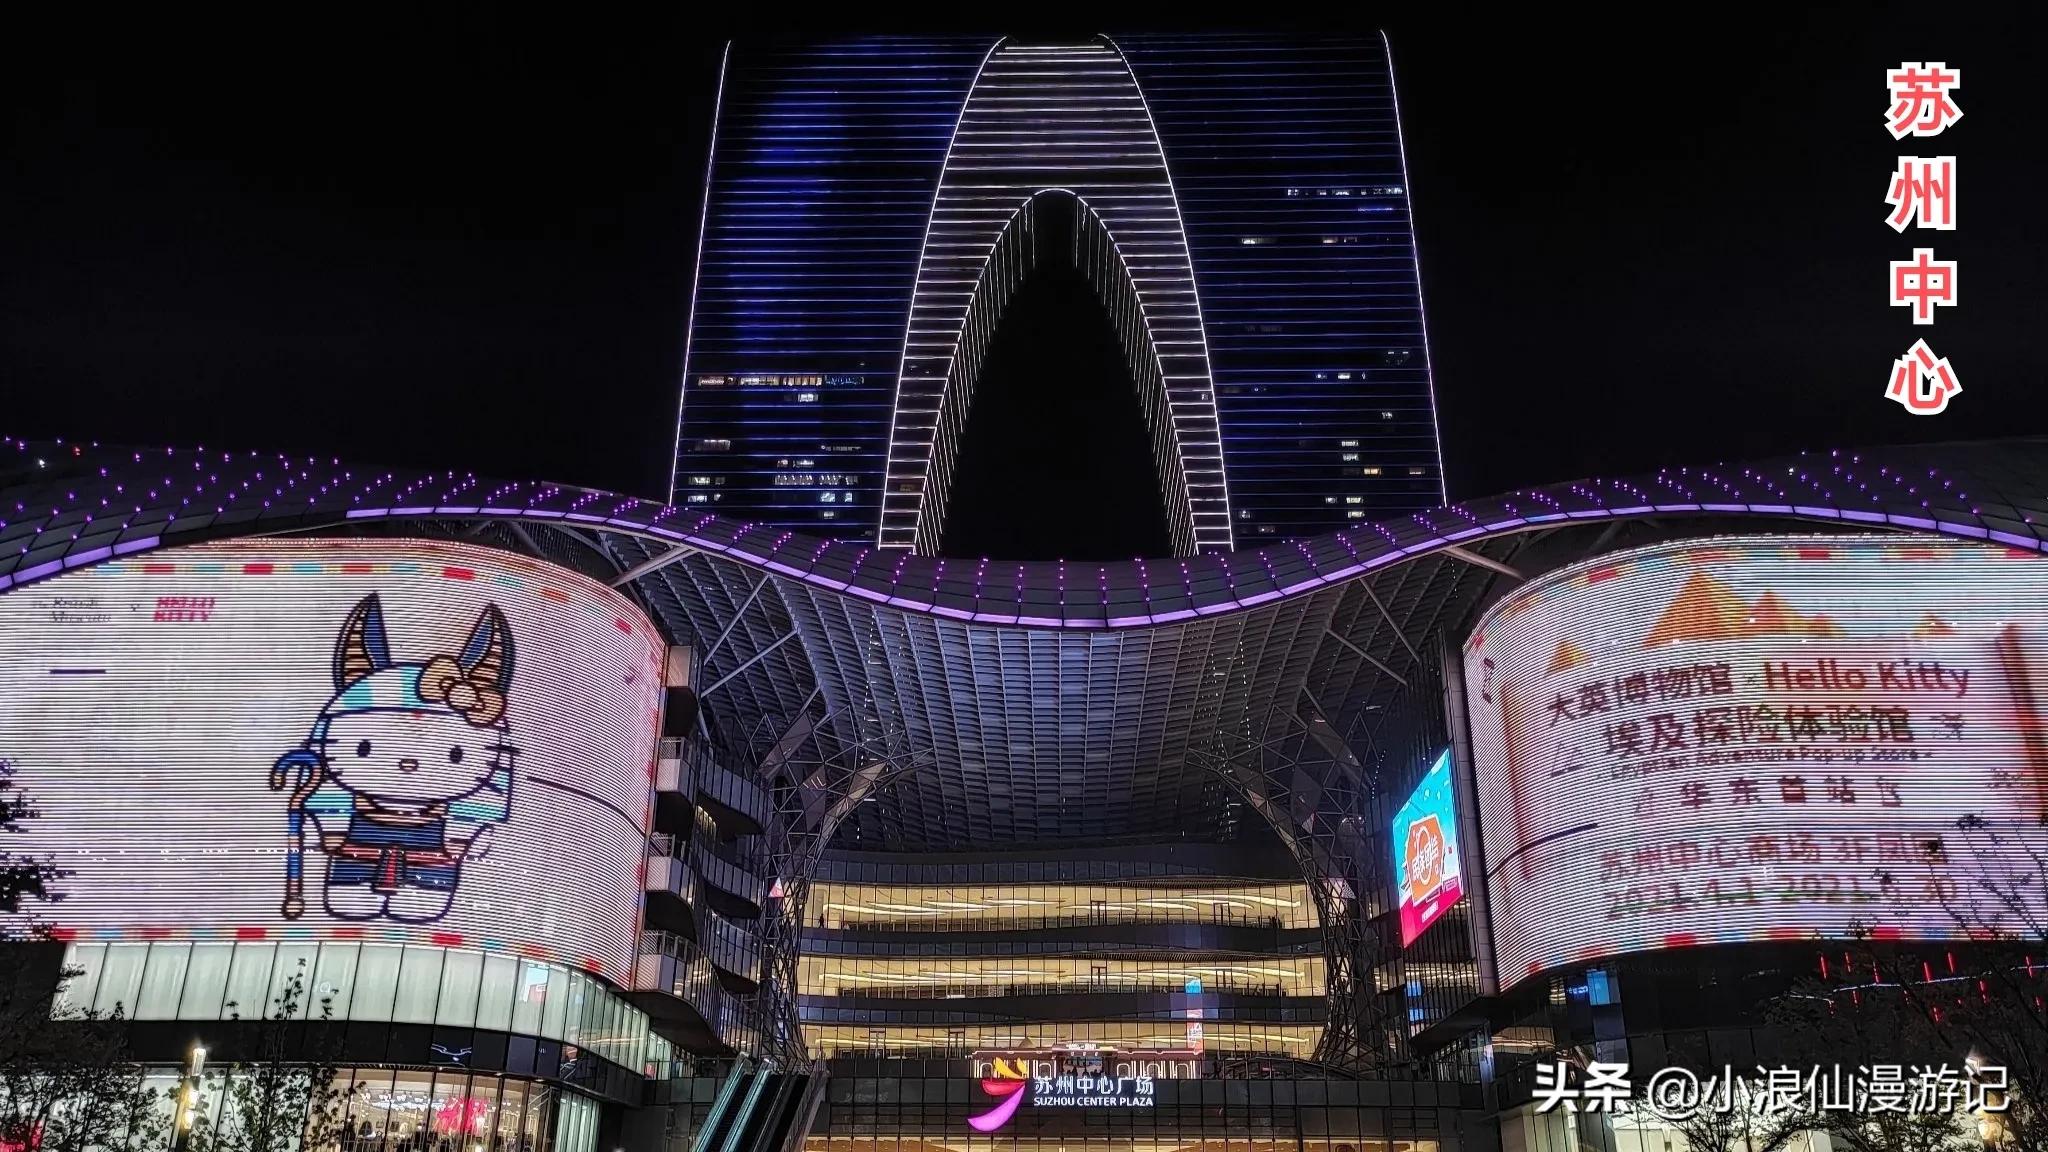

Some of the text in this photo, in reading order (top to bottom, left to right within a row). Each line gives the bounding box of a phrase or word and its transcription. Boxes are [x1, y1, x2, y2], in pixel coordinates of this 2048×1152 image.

[1546, 662, 1733, 728] 大英博物馆
[1763, 658, 1970, 698] Hello Kitty
[1604, 702, 1916, 759] 埃及探险体验馆
[1680, 775, 1857, 810] 华东首站
[1033, 1096, 1154, 1107] SUZHOU CENTER PLAZA
[1034, 1075, 1154, 1095] 苏州中心广场
